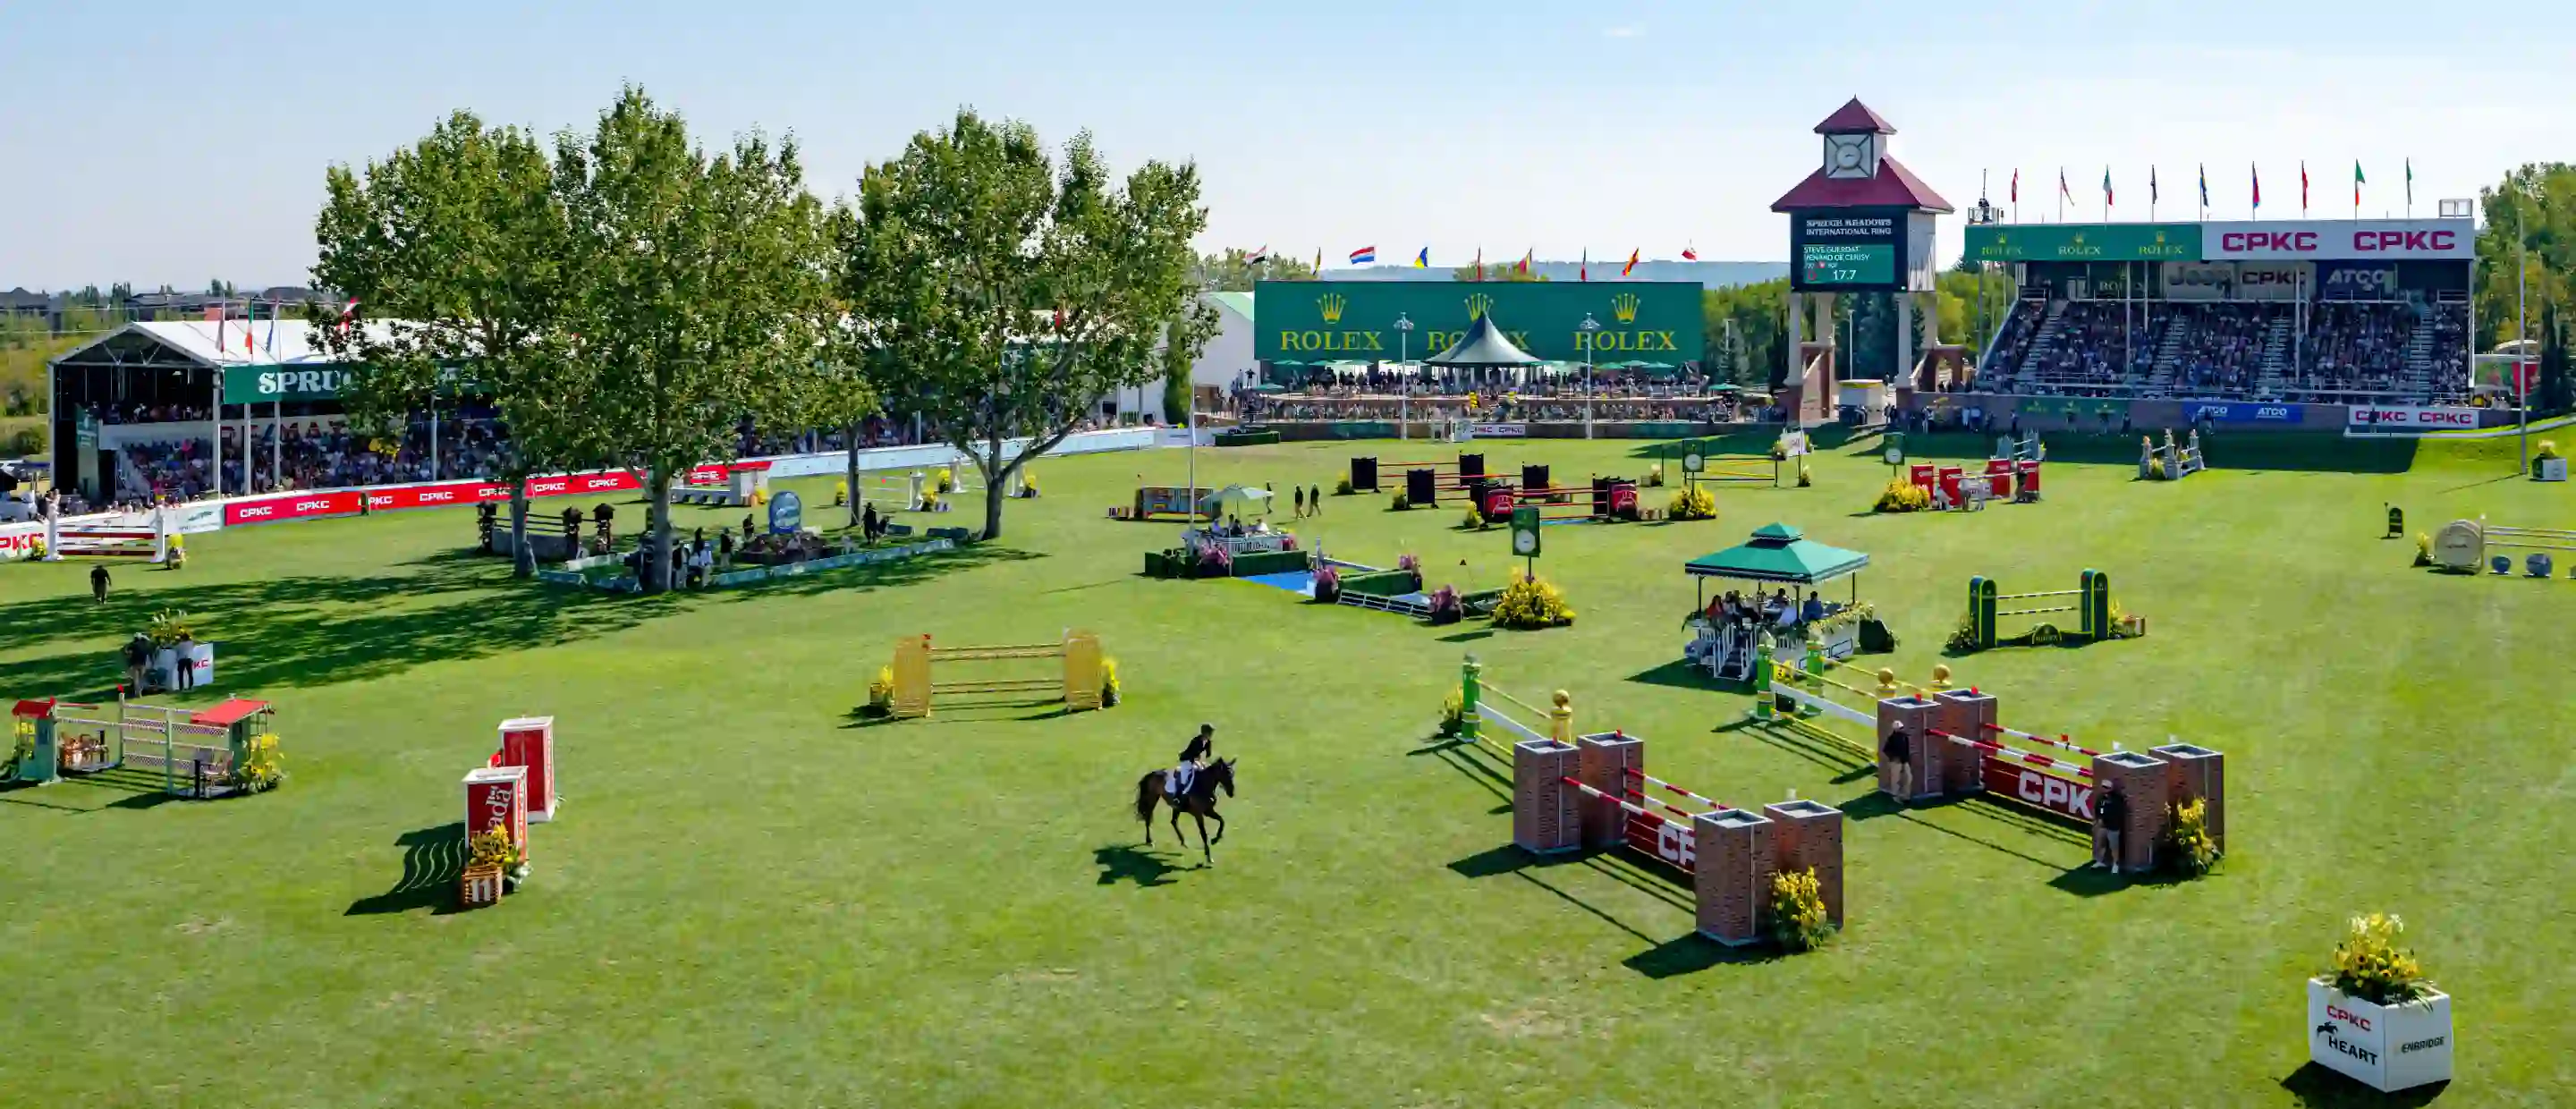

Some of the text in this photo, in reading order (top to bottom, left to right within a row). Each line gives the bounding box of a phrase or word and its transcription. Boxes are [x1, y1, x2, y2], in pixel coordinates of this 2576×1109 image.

[1806, 227, 1893, 235] INTERNATIONAL RING
[2222, 231, 2456, 252] CPKC CPKC
[2058, 246, 2101, 255] ROLEX
[2139, 245, 2183, 255] ROLEX
[1833, 269, 1857, 281] 17.7
[2241, 270, 2307, 285] CPKC
[1280, 330, 1385, 351] ROLEX
[1572, 330, 1679, 351] ROLEX
[2257, 407, 2288, 417] ATCO
[2355, 410, 2472, 425] CKC CPKC
[534, 482, 565, 492] CPKC
[588, 478, 618, 488] CPKC
[419, 491, 454, 502] CPKC
[239, 506, 273, 518] CPKC
[296, 500, 330, 512] CPKC
[191, 659, 209, 669] KC
[2018, 771, 2094, 820] CPK
[2326, 1004, 2371, 1032] CPKC
[2328, 1035, 2378, 1066] HEART
[2401, 1036, 2445, 1054] ENBRIDGE
